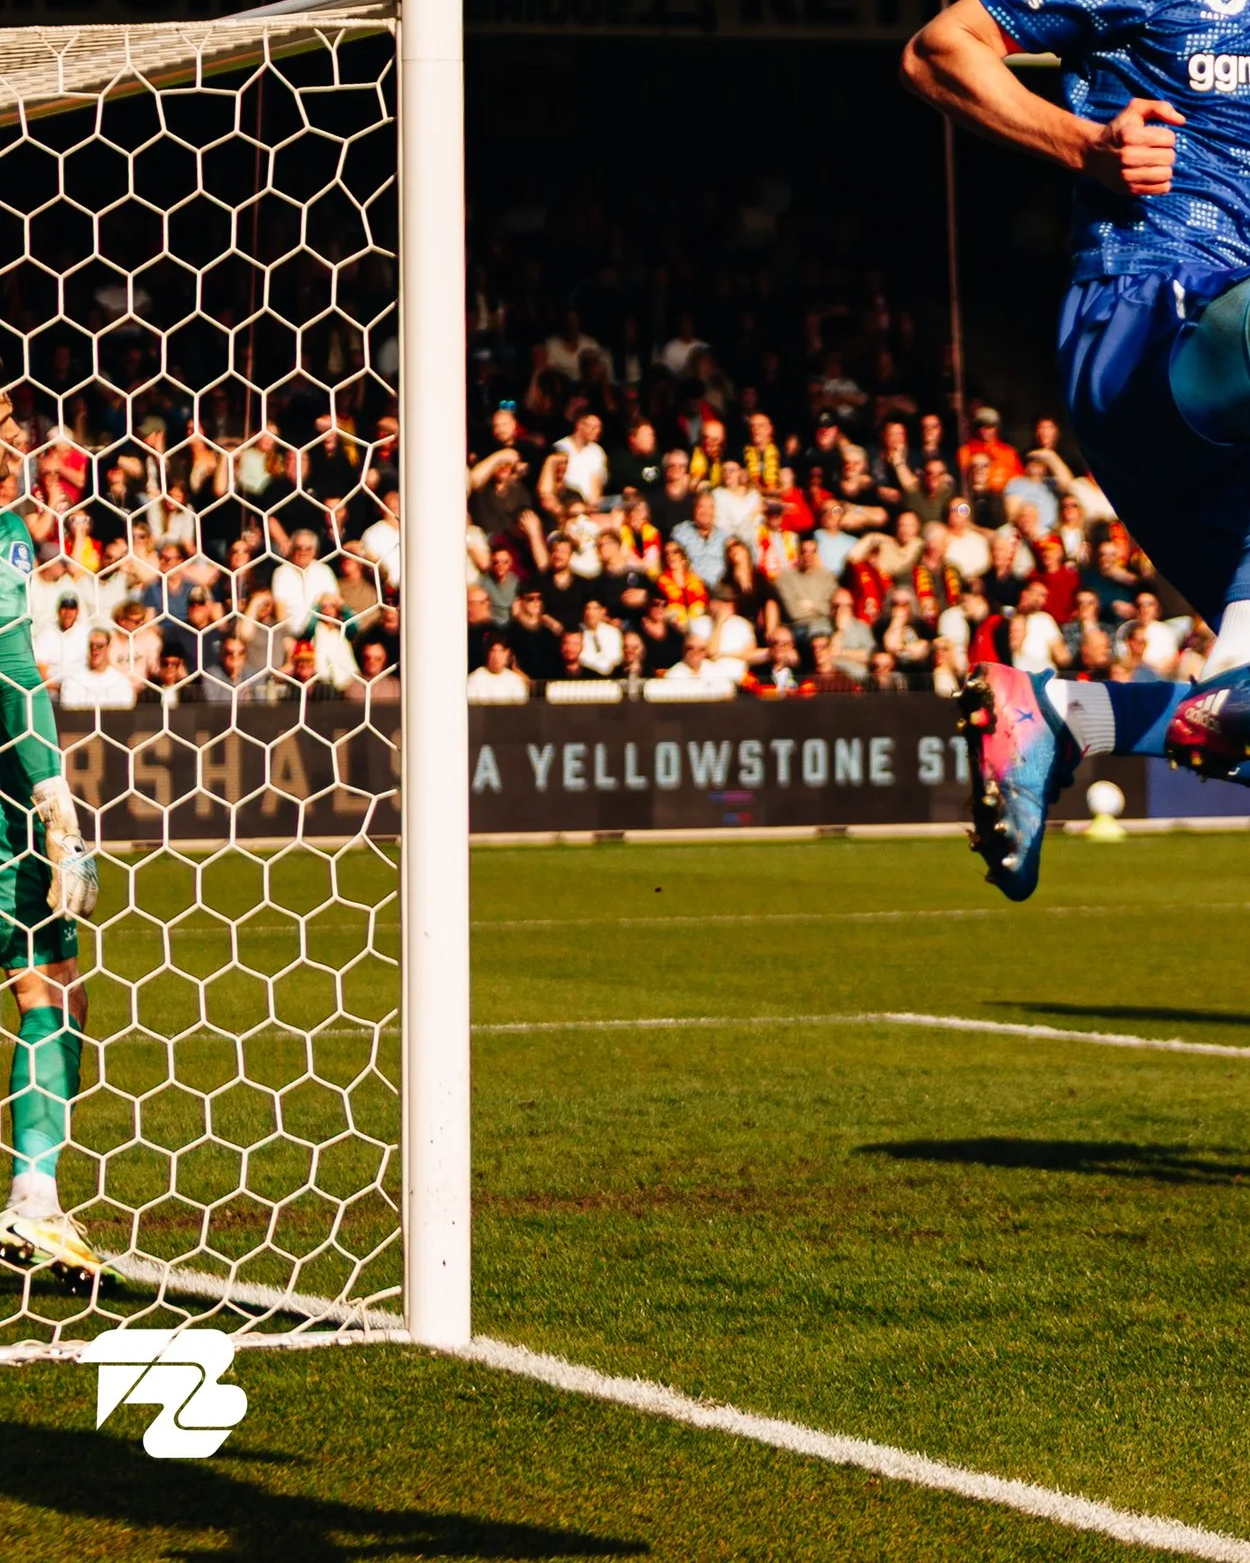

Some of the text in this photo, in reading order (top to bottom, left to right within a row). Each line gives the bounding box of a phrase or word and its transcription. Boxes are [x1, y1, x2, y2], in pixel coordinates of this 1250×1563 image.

[62, 728, 403, 820] RSHAL
[471, 746, 502, 791] A
[527, 736, 896, 791] YELLOWSTONE
